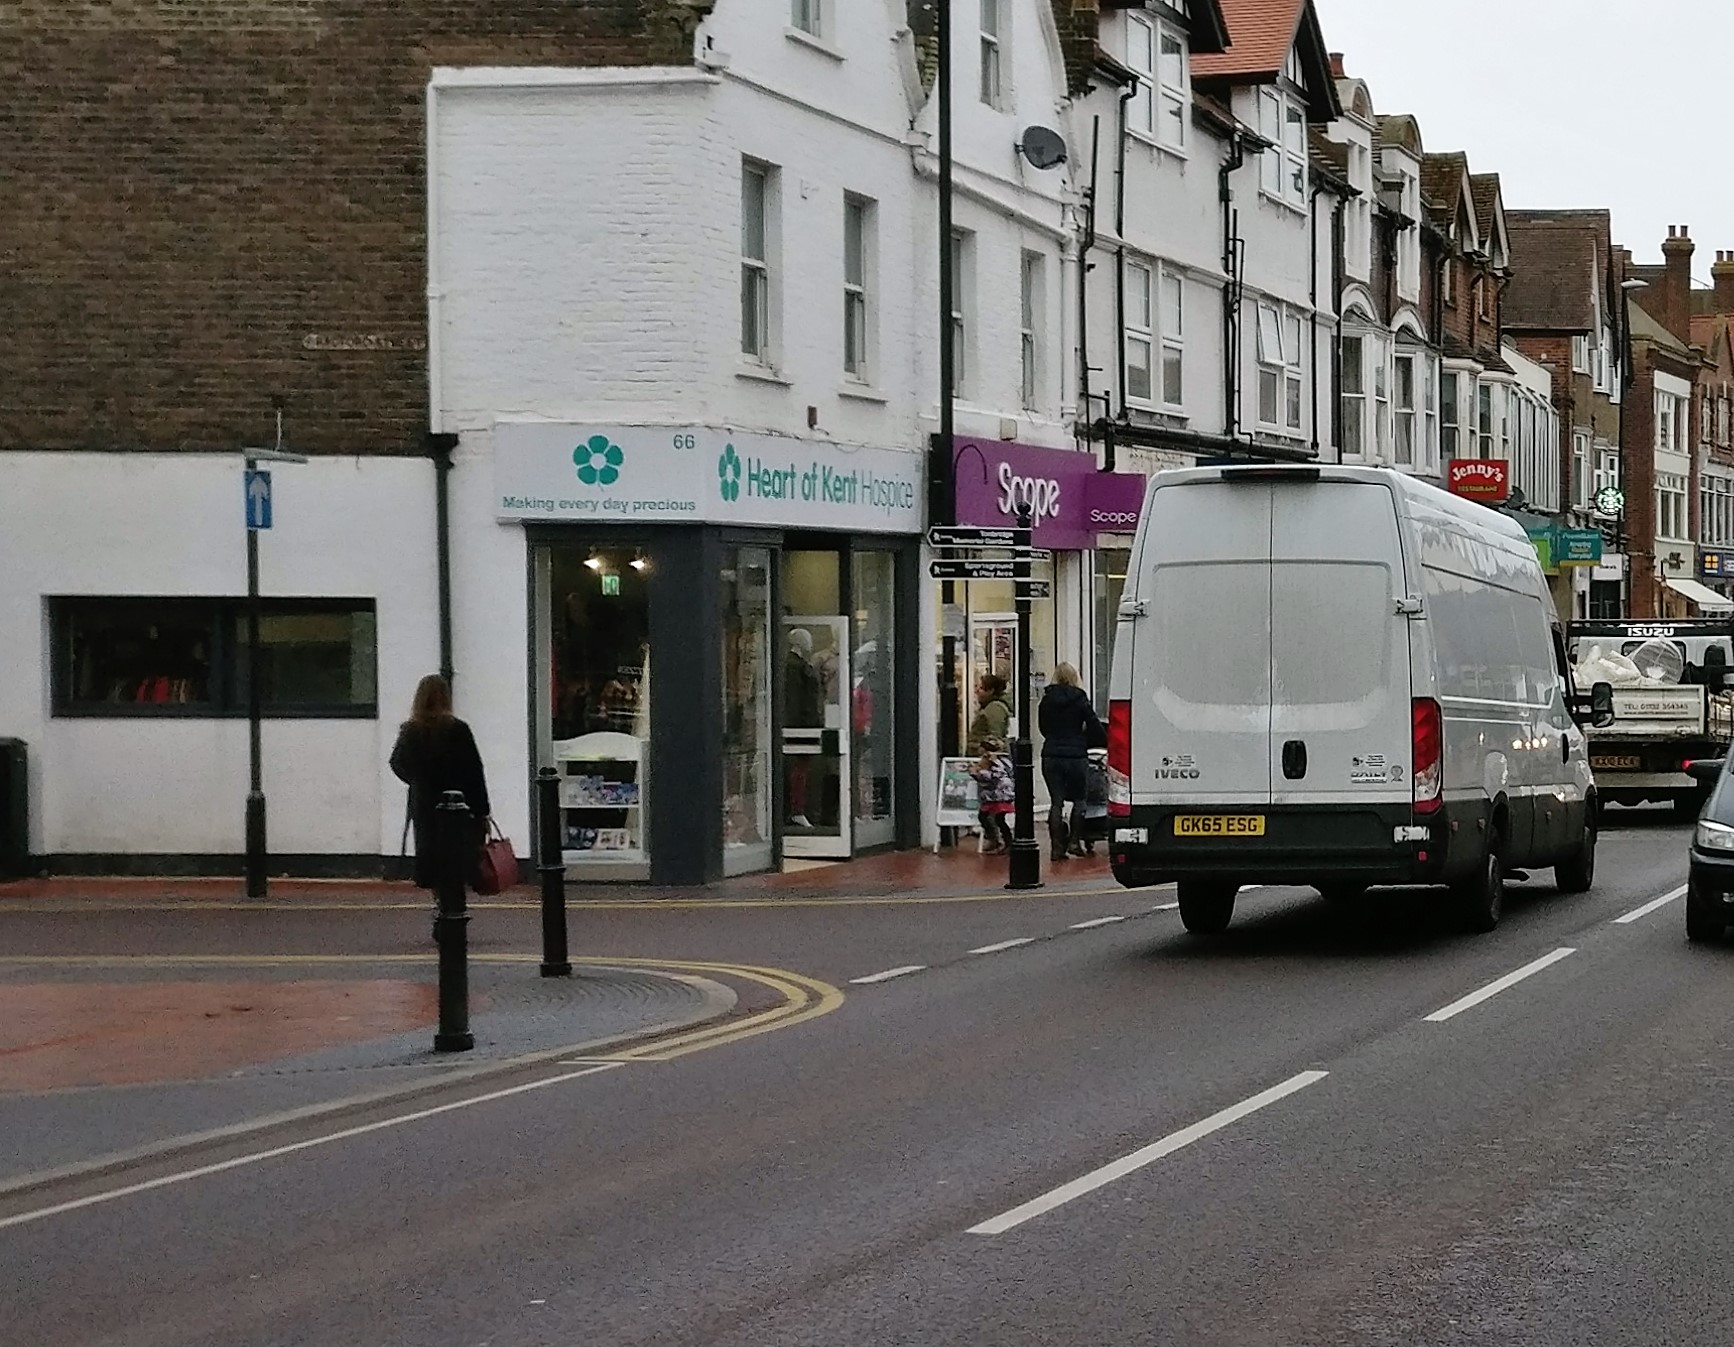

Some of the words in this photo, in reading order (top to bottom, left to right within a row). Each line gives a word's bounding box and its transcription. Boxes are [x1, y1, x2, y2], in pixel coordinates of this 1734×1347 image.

[673, 434, 695, 449] 66
[1452, 463, 1504, 482] Jenny's
[747, 457, 796, 500] Heart
[801, 464, 818, 501] of
[822, 464, 859, 505] Kent
[861, 469, 914, 520] Hospice
[998, 462, 1060, 528] Scope
[503, 496, 555, 512] Making
[559, 498, 599, 513] every
[603, 497, 629, 514] day
[633, 498, 696, 514] precious
[1090, 508, 1137, 525] Scope
[1628, 628, 1674, 636] ISUZU
[1154, 768, 1200, 779] IVECO
[1181, 817, 1222, 832] GK65
[1226, 817, 1258, 832] ESG
